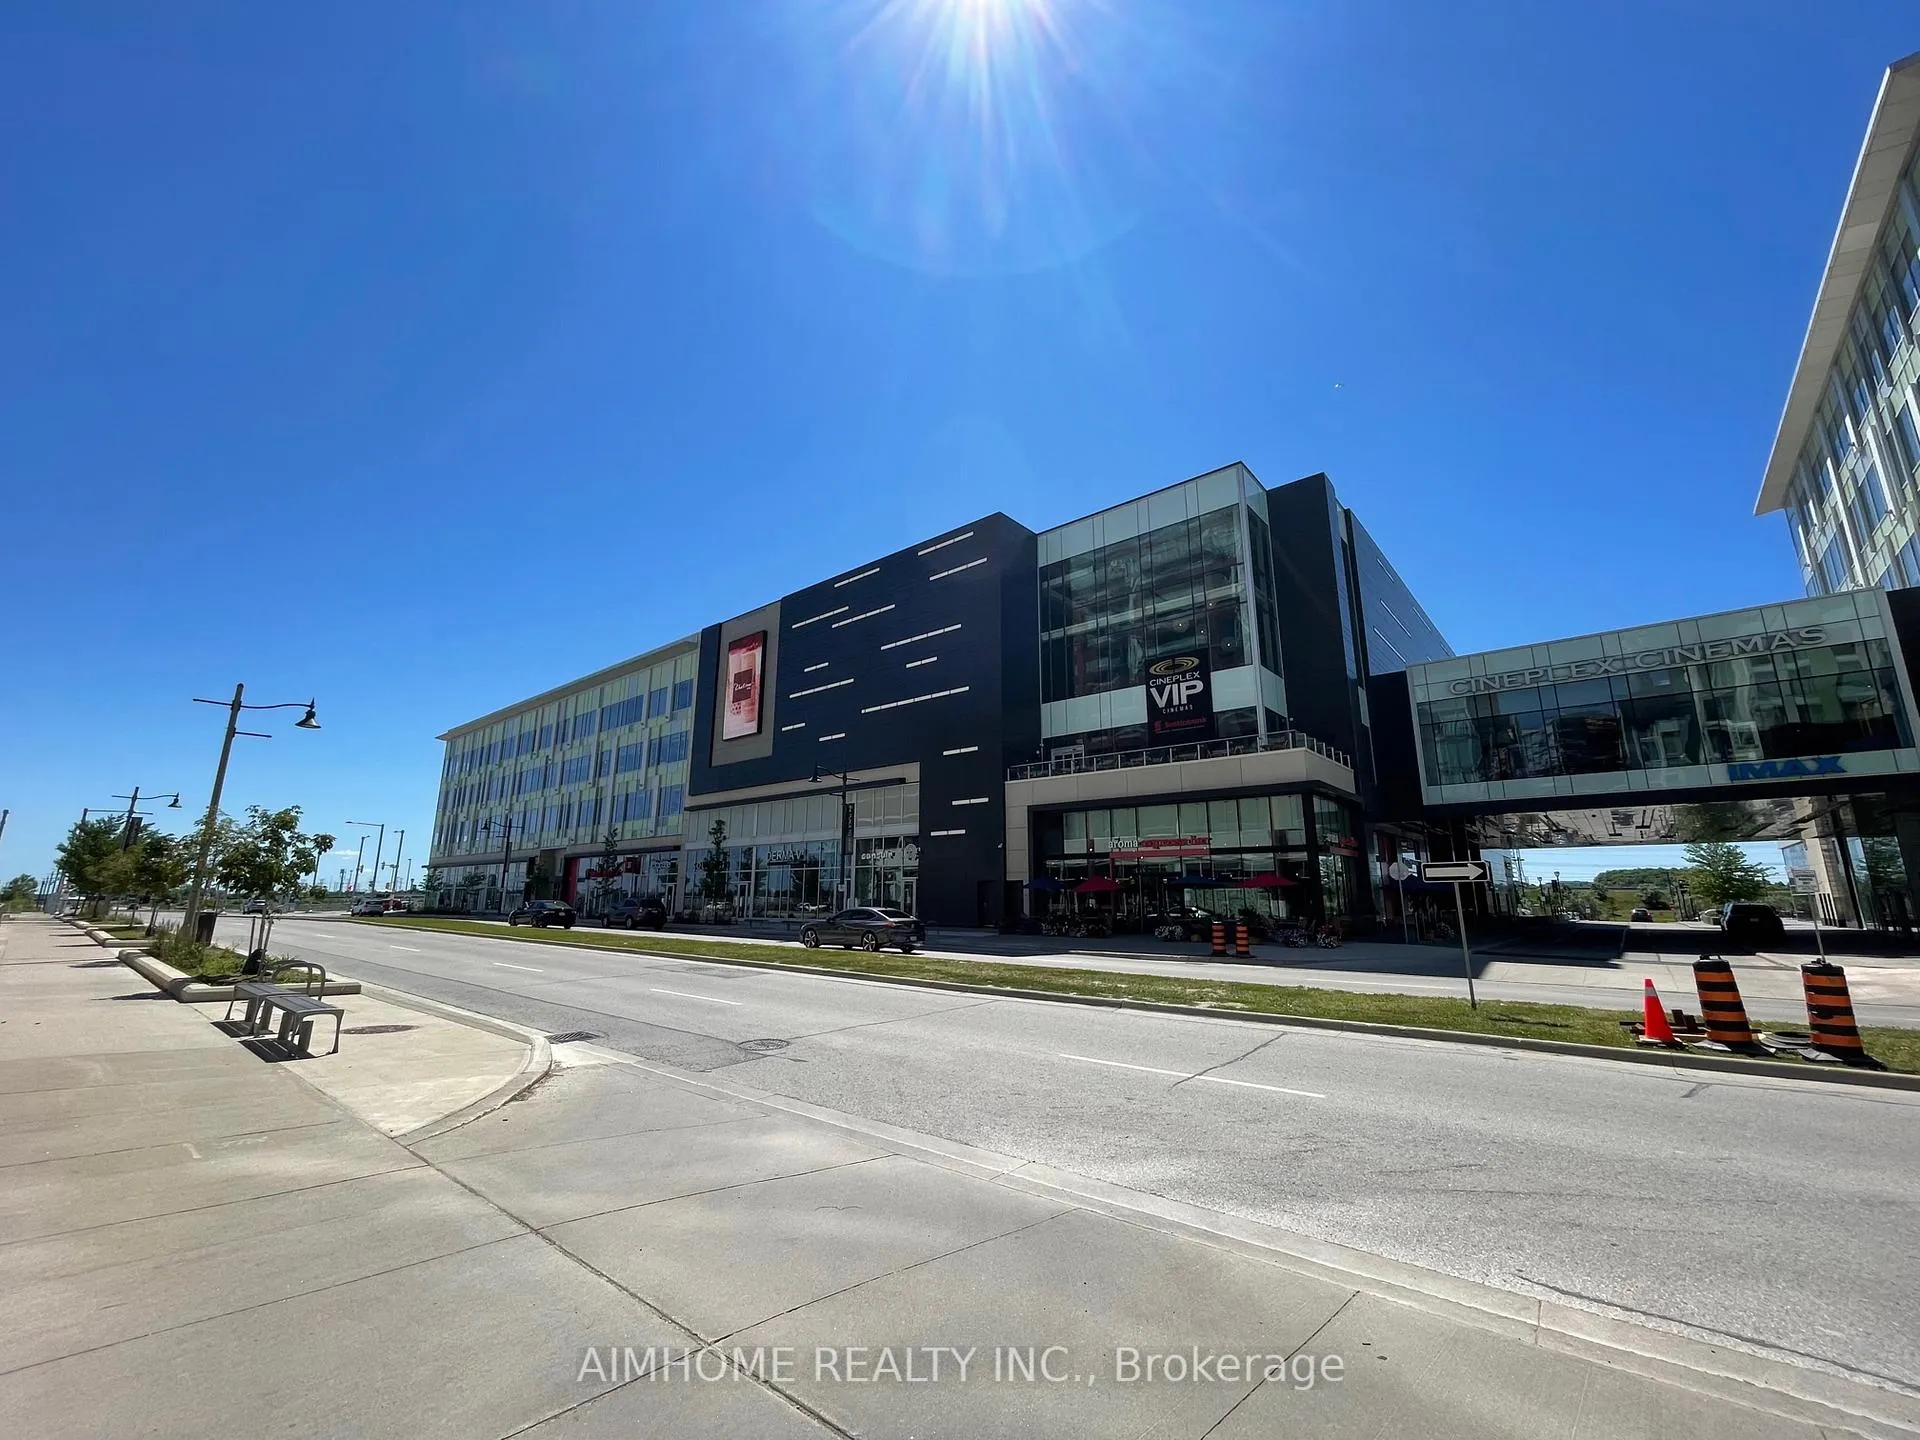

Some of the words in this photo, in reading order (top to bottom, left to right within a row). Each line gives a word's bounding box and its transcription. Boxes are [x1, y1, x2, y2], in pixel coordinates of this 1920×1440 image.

[1450, 657, 1617, 695] CINEPLEX
[1634, 627, 1828, 668] CINEMAS
[1149, 671, 1200, 686] CINEPLEX
[1149, 680, 1204, 708] VIP
[1163, 704, 1193, 714] CINEMAS
[1727, 755, 1848, 781] IMAX
[1108, 839, 1138, 849] aroma
